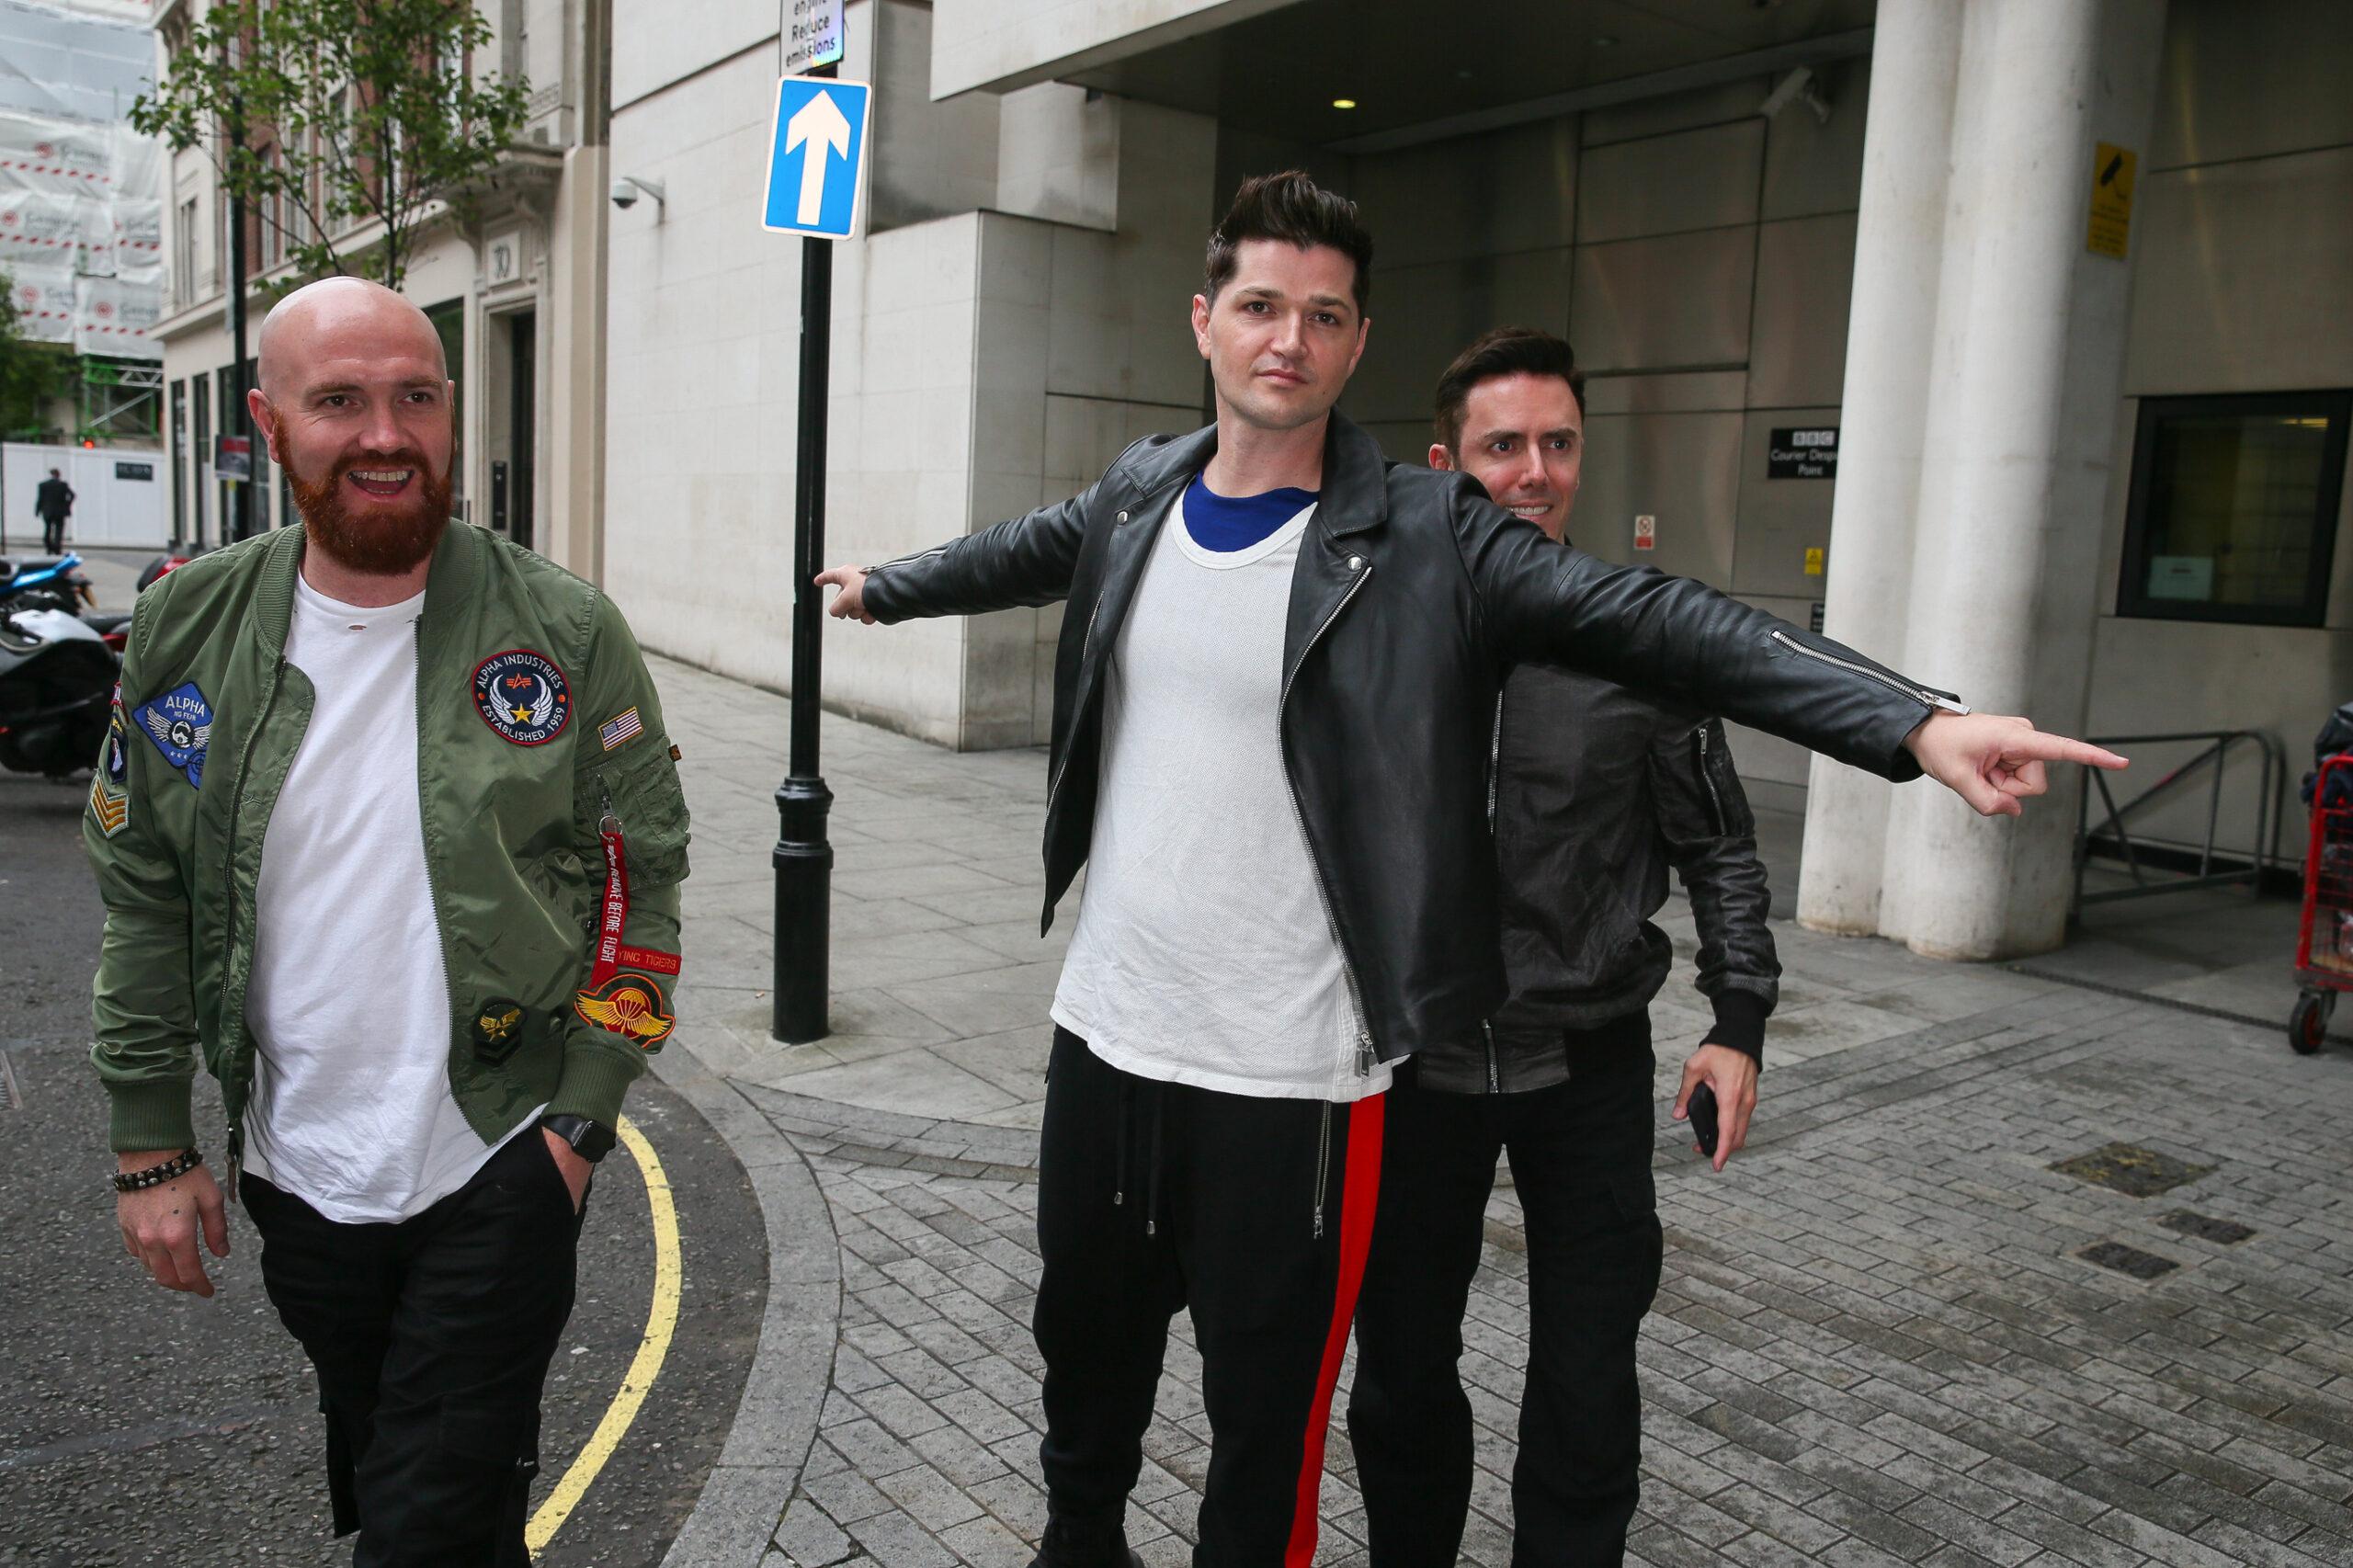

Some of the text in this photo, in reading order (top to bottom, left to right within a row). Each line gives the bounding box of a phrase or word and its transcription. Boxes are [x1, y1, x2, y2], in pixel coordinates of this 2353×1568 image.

[792, 16, 829, 42] Reduce
[787, 37, 835, 67] emissions
[1792, 430, 1835, 446] BBC
[1770, 448, 1807, 461] Courier
[1798, 462, 1824, 476] Point
[477, 654, 563, 689] ALPHA INDUSTRIES
[165, 696, 205, 717] ALPHA
[483, 705, 565, 742] ESTABLISHED 1959
[600, 868, 624, 964] REMOVE BEFORE FLIGHT
[645, 954, 677, 970] TIGERS
